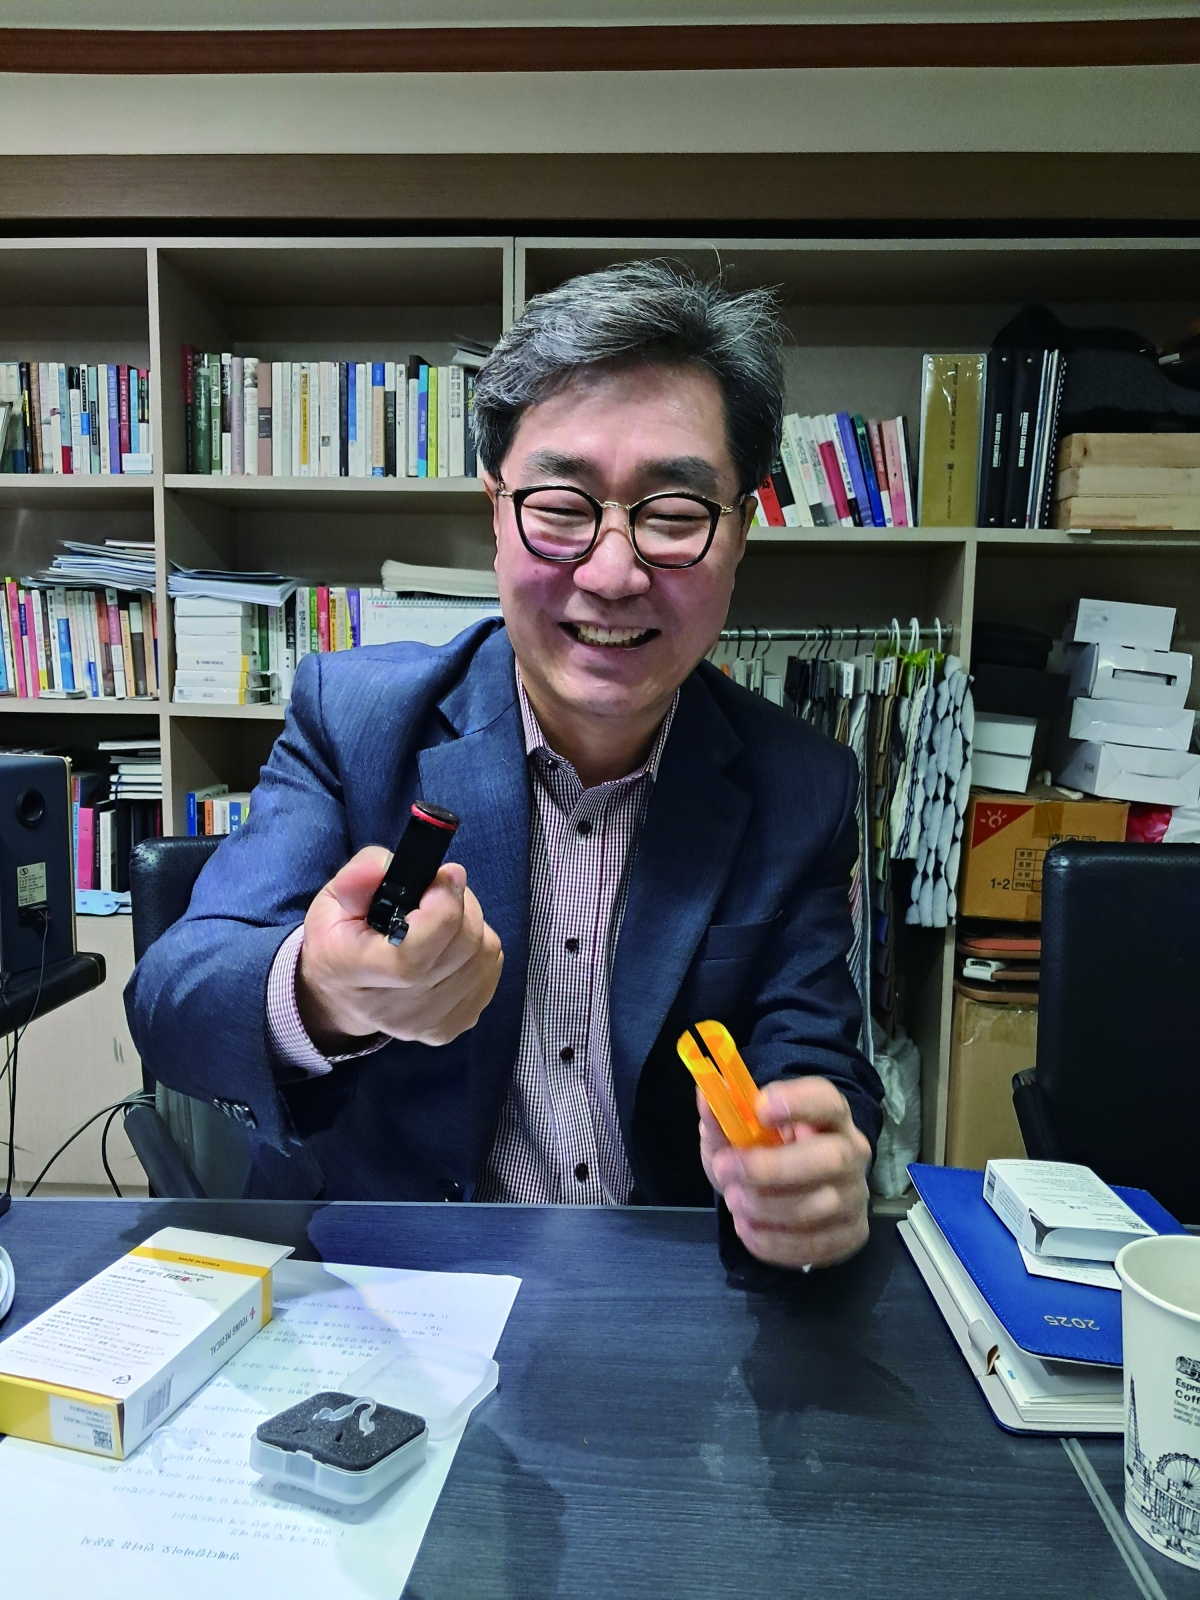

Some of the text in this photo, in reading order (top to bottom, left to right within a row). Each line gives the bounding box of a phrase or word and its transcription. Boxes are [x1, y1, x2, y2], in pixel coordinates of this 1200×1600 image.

[990, 877, 1010, 890] 1-2
[178, 1256, 194, 1264] MADE
[201, 1260, 220, 1268] KOREA
[1042, 1315, 1099, 1331] 2025
[210, 1315, 248, 1356] YOUNG MEDICAL
